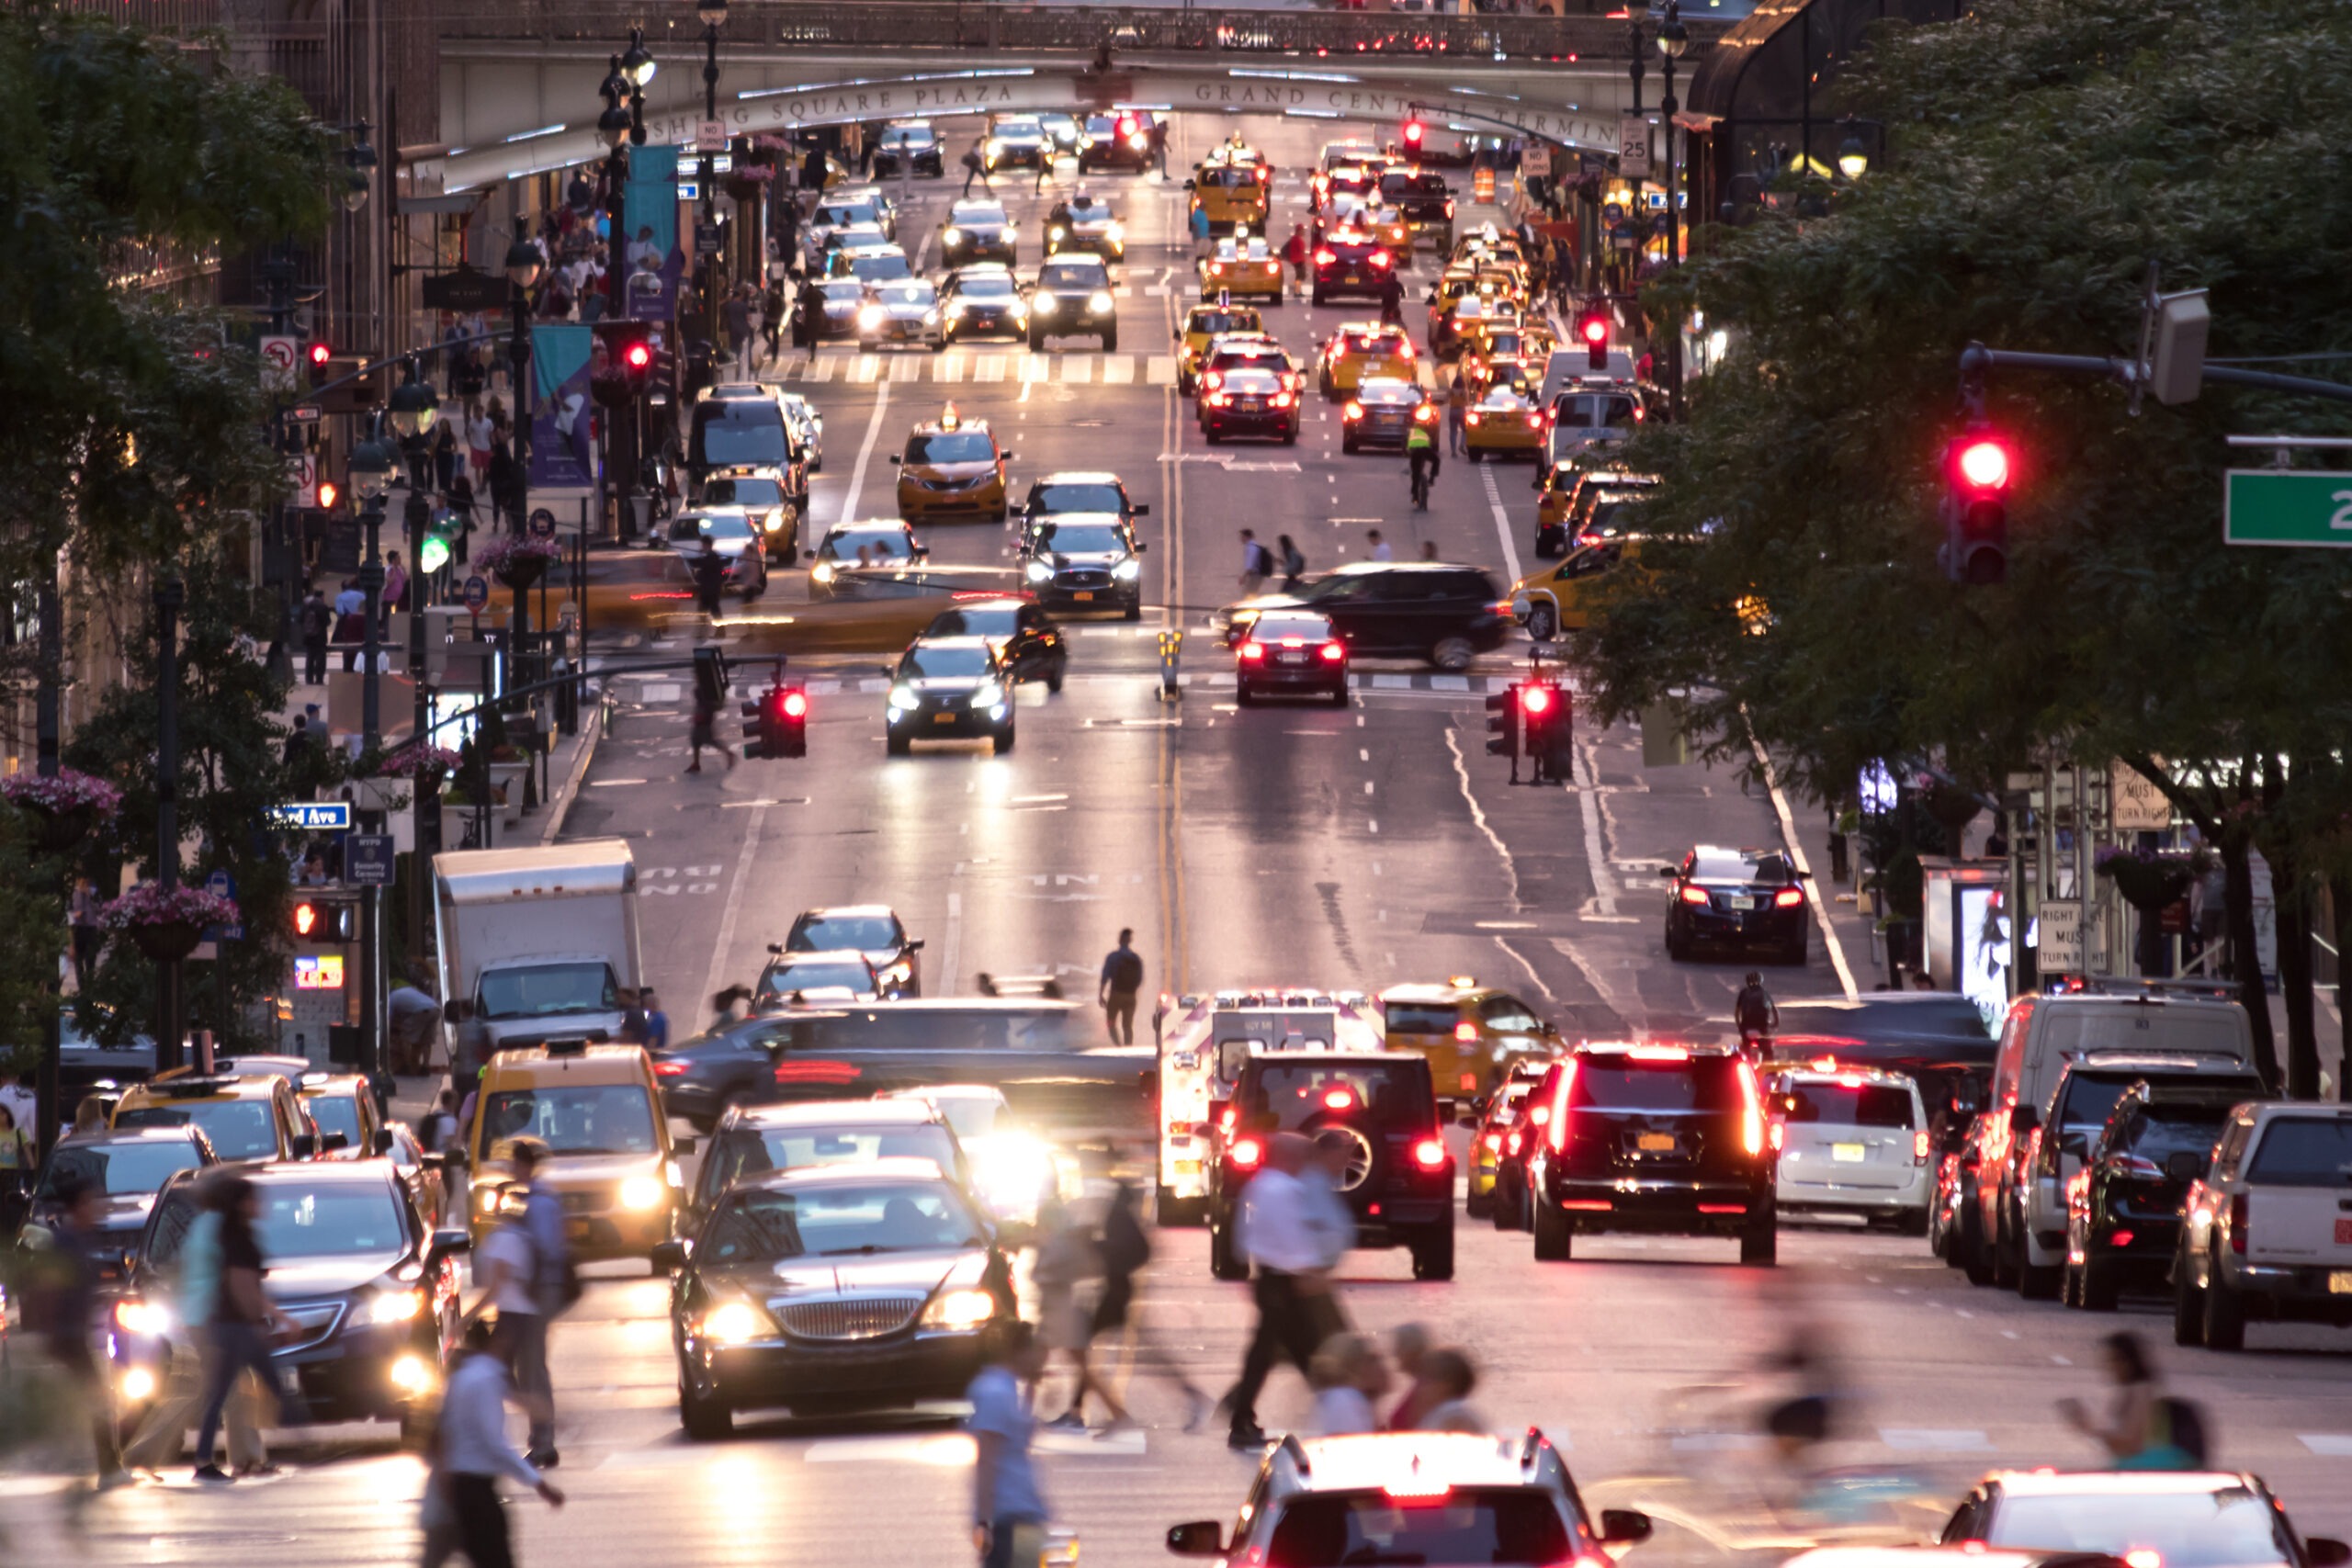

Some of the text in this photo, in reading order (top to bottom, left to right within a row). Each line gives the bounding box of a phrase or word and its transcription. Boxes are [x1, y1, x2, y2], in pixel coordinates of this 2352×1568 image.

[773, 92, 891, 119] SQUARE
[915, 85, 1012, 105] PLAZA
[1196, 85, 1305, 104] GRAND
[1493, 107, 1615, 142] TERMIN
[705, 126, 718, 135] NO
[698, 138, 723, 147] TURNS
[1623, 141, 1646, 158] 25
[1529, 152, 1543, 161] NO
[1523, 163, 1550, 172] TURNS
[2127, 783, 2155, 798] MUST
[309, 808, 336, 824] Ave
[2117, 807, 2140, 819] TURN
[2042, 909, 2074, 922] RIGHT
[2055, 931, 2084, 945] MUS
[2041, 952, 2070, 964] TURN
